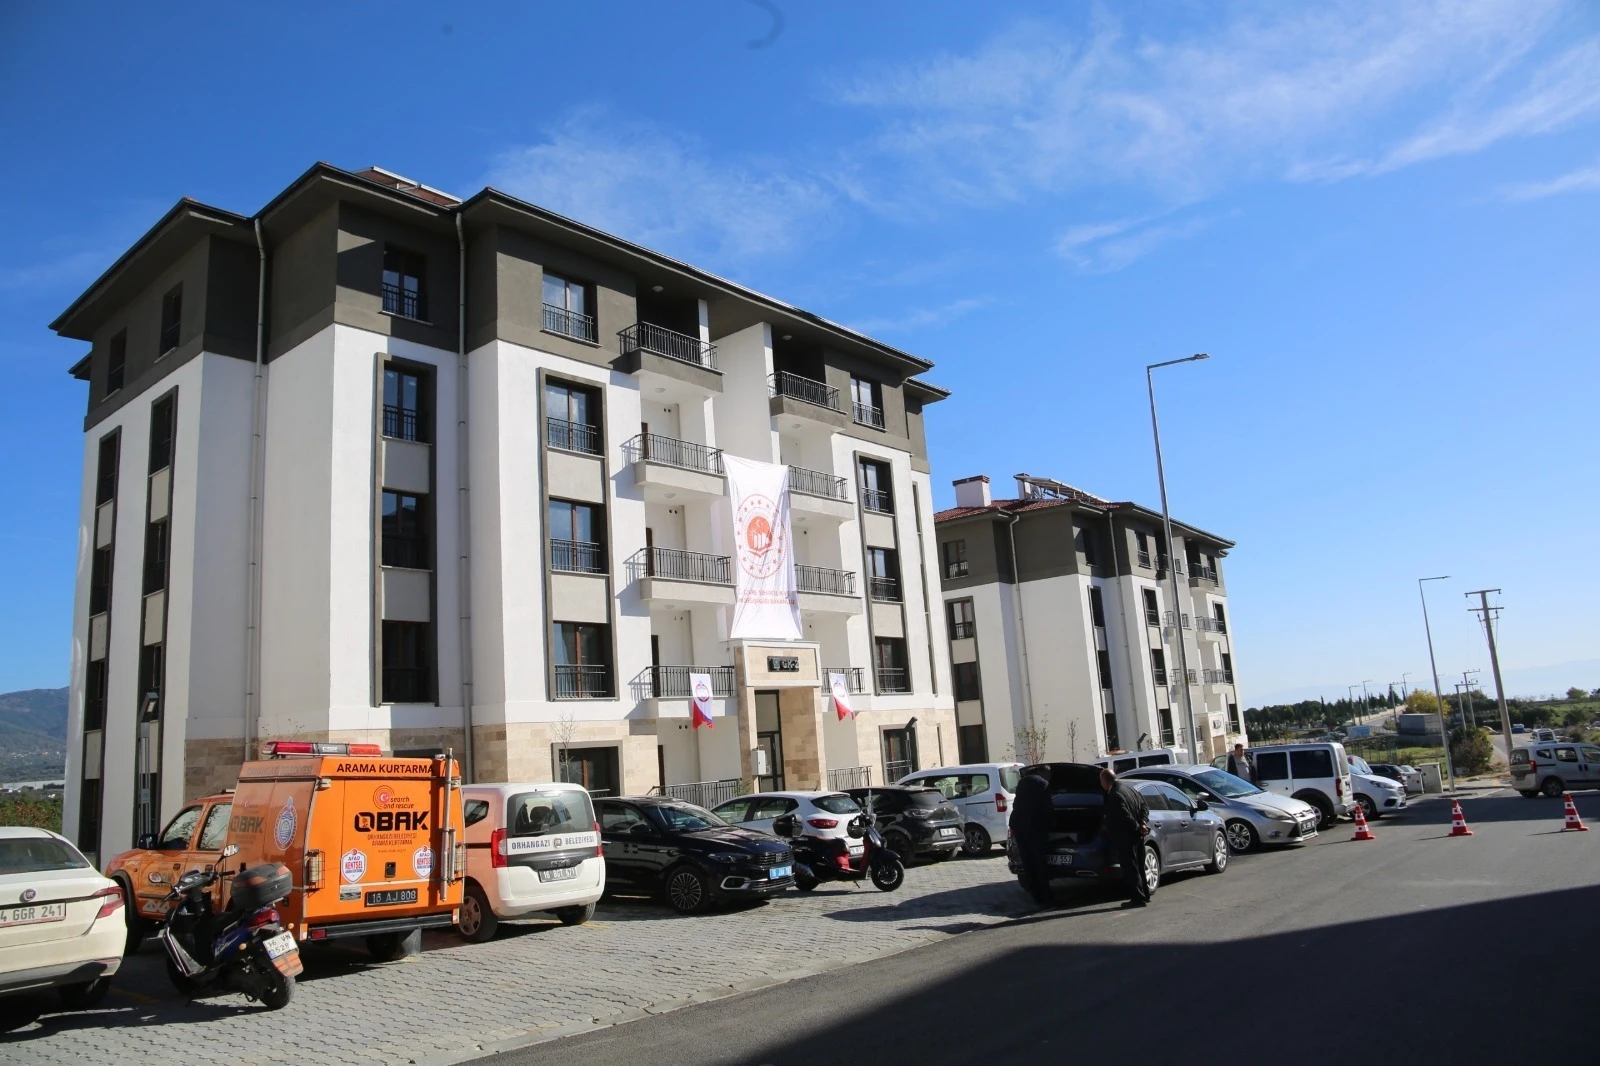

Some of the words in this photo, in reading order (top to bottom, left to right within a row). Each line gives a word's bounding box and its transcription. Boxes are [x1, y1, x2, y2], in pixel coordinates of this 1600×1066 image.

[337, 763, 376, 773] ARAMA
[379, 764, 434, 774] KURTARMA
[354, 811, 430, 832] OBAK
[511, 838, 550, 850] ORHANGAZİ
[565, 835, 594, 845] BELEDİYESİ
[345, 861, 363, 869] KENTSEL
[543, 870, 551, 879] 16
[372, 893, 381, 903] 16
[386, 891, 399, 902] AJ
[400, 890, 416, 900] 808
[13, 907, 35, 921] GGR
[41, 904, 62, 918] 241
